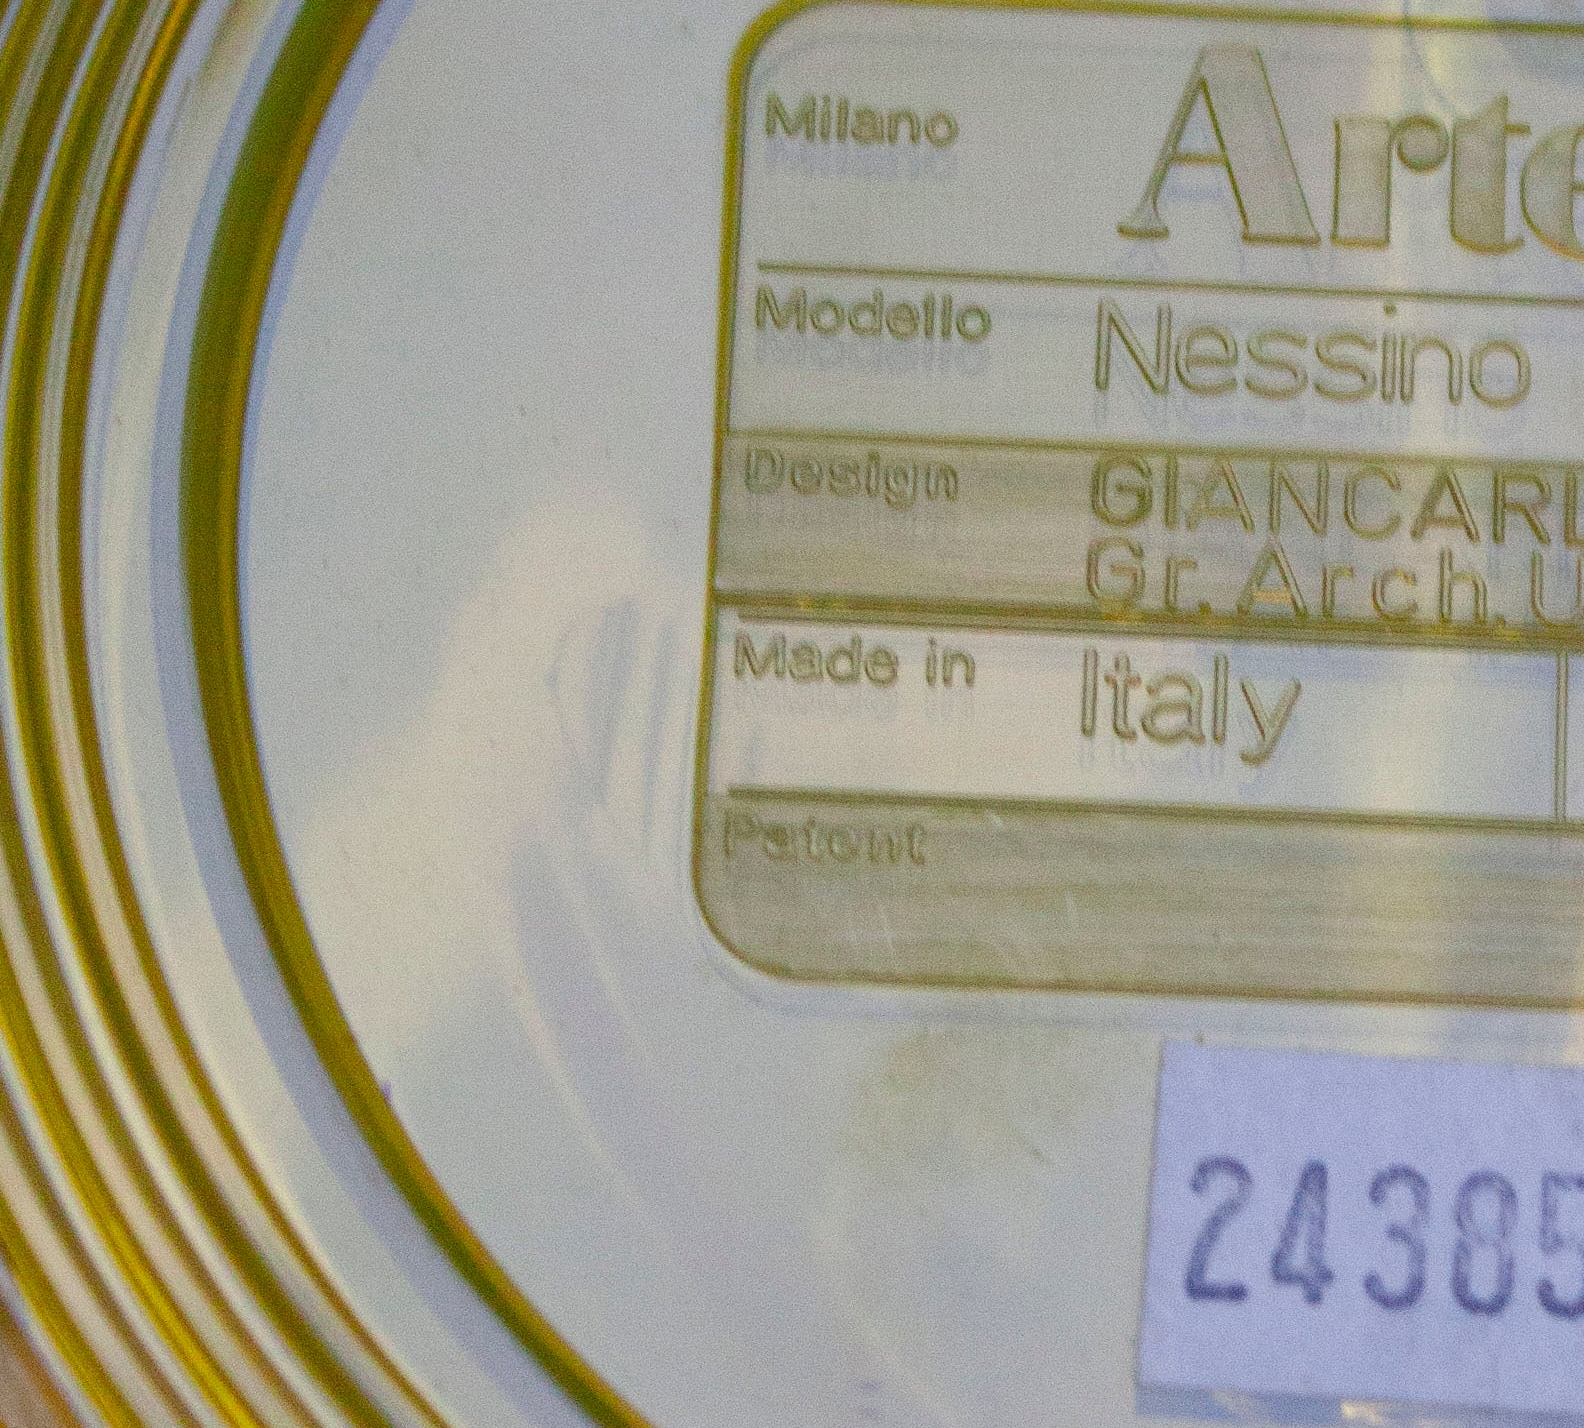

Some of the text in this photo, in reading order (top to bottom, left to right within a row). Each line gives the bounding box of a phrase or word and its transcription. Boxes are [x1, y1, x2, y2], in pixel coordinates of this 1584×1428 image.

[764, 90, 959, 148] Milano
[754, 284, 992, 344] Modello
[1093, 298, 1533, 409] Nessino
[744, 448, 959, 511] Design
[732, 633, 977, 689] Made in
[1078, 646, 1303, 767] Italy
[721, 814, 927, 867] Patent
